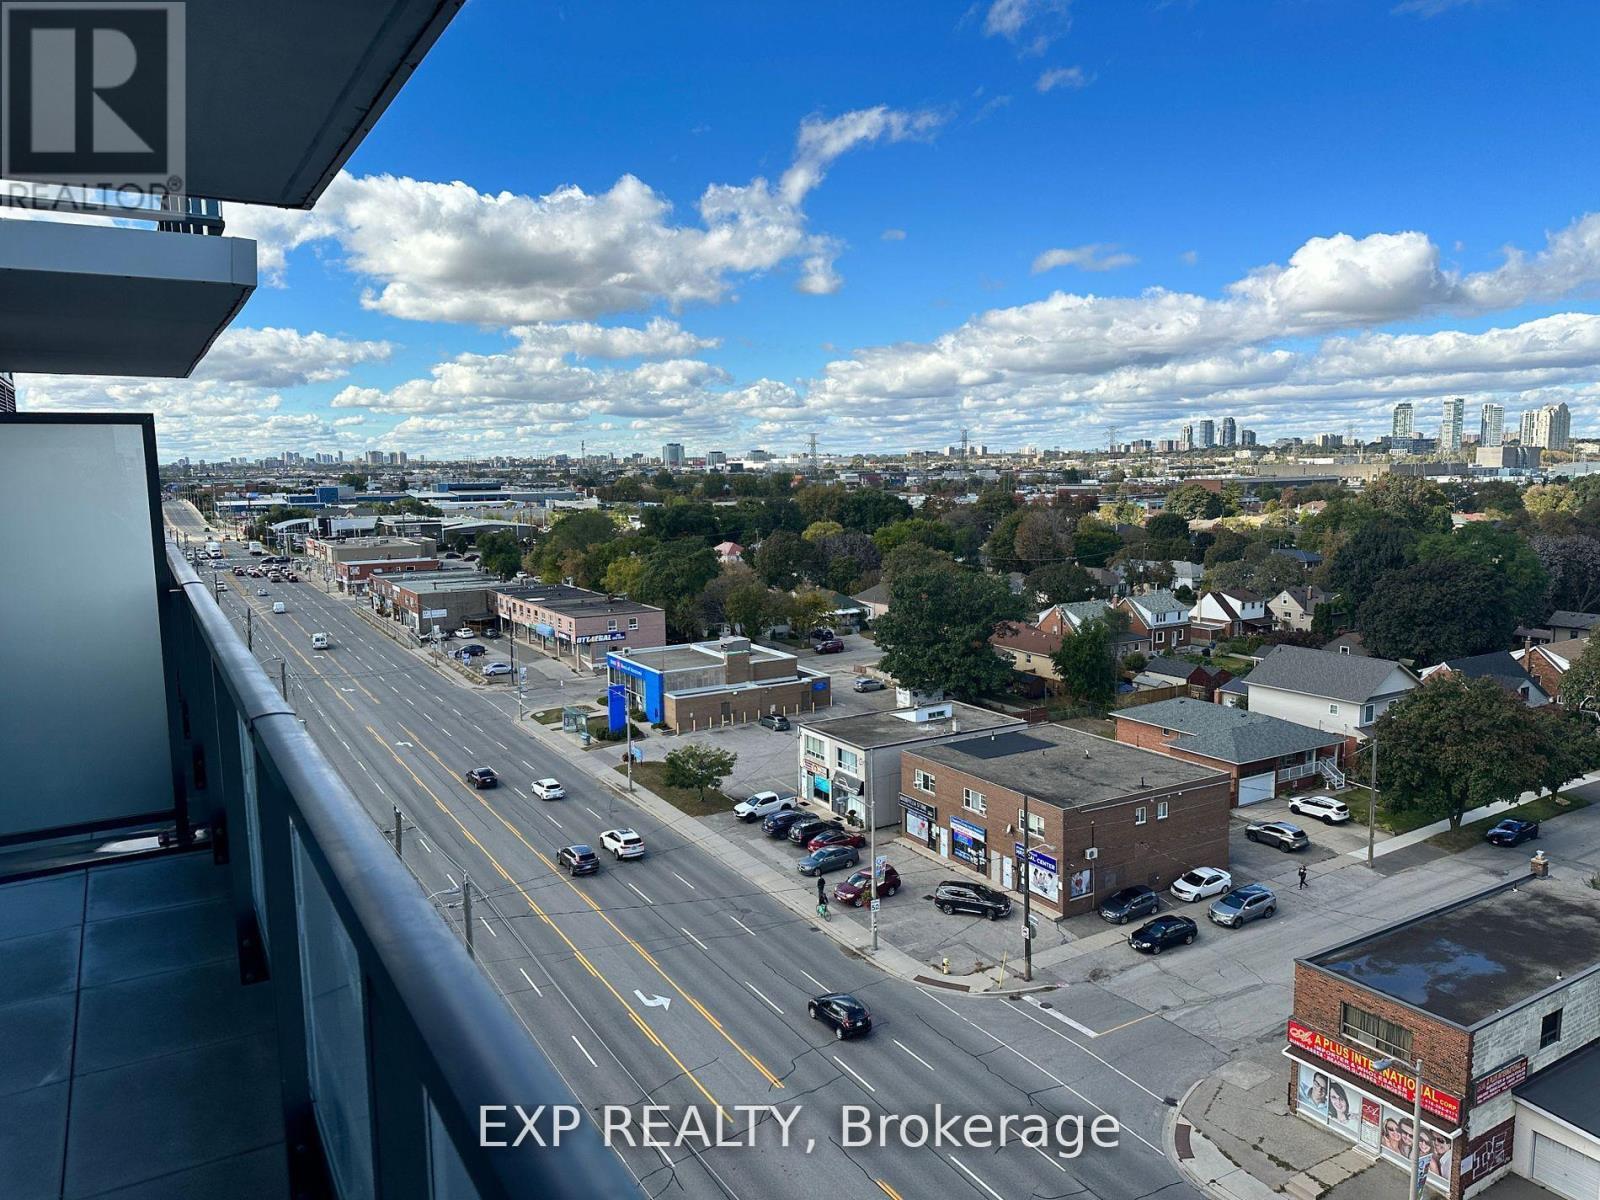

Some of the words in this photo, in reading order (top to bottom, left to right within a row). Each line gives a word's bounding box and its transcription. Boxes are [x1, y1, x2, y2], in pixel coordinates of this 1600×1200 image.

[1314, 1044, 1350, 1065] IMPORTER
[1315, 1034, 1322, 1046] A
[1323, 1038, 1349, 1059] PLUS
[1351, 1051, 1439, 1103] INTENATIOAL
